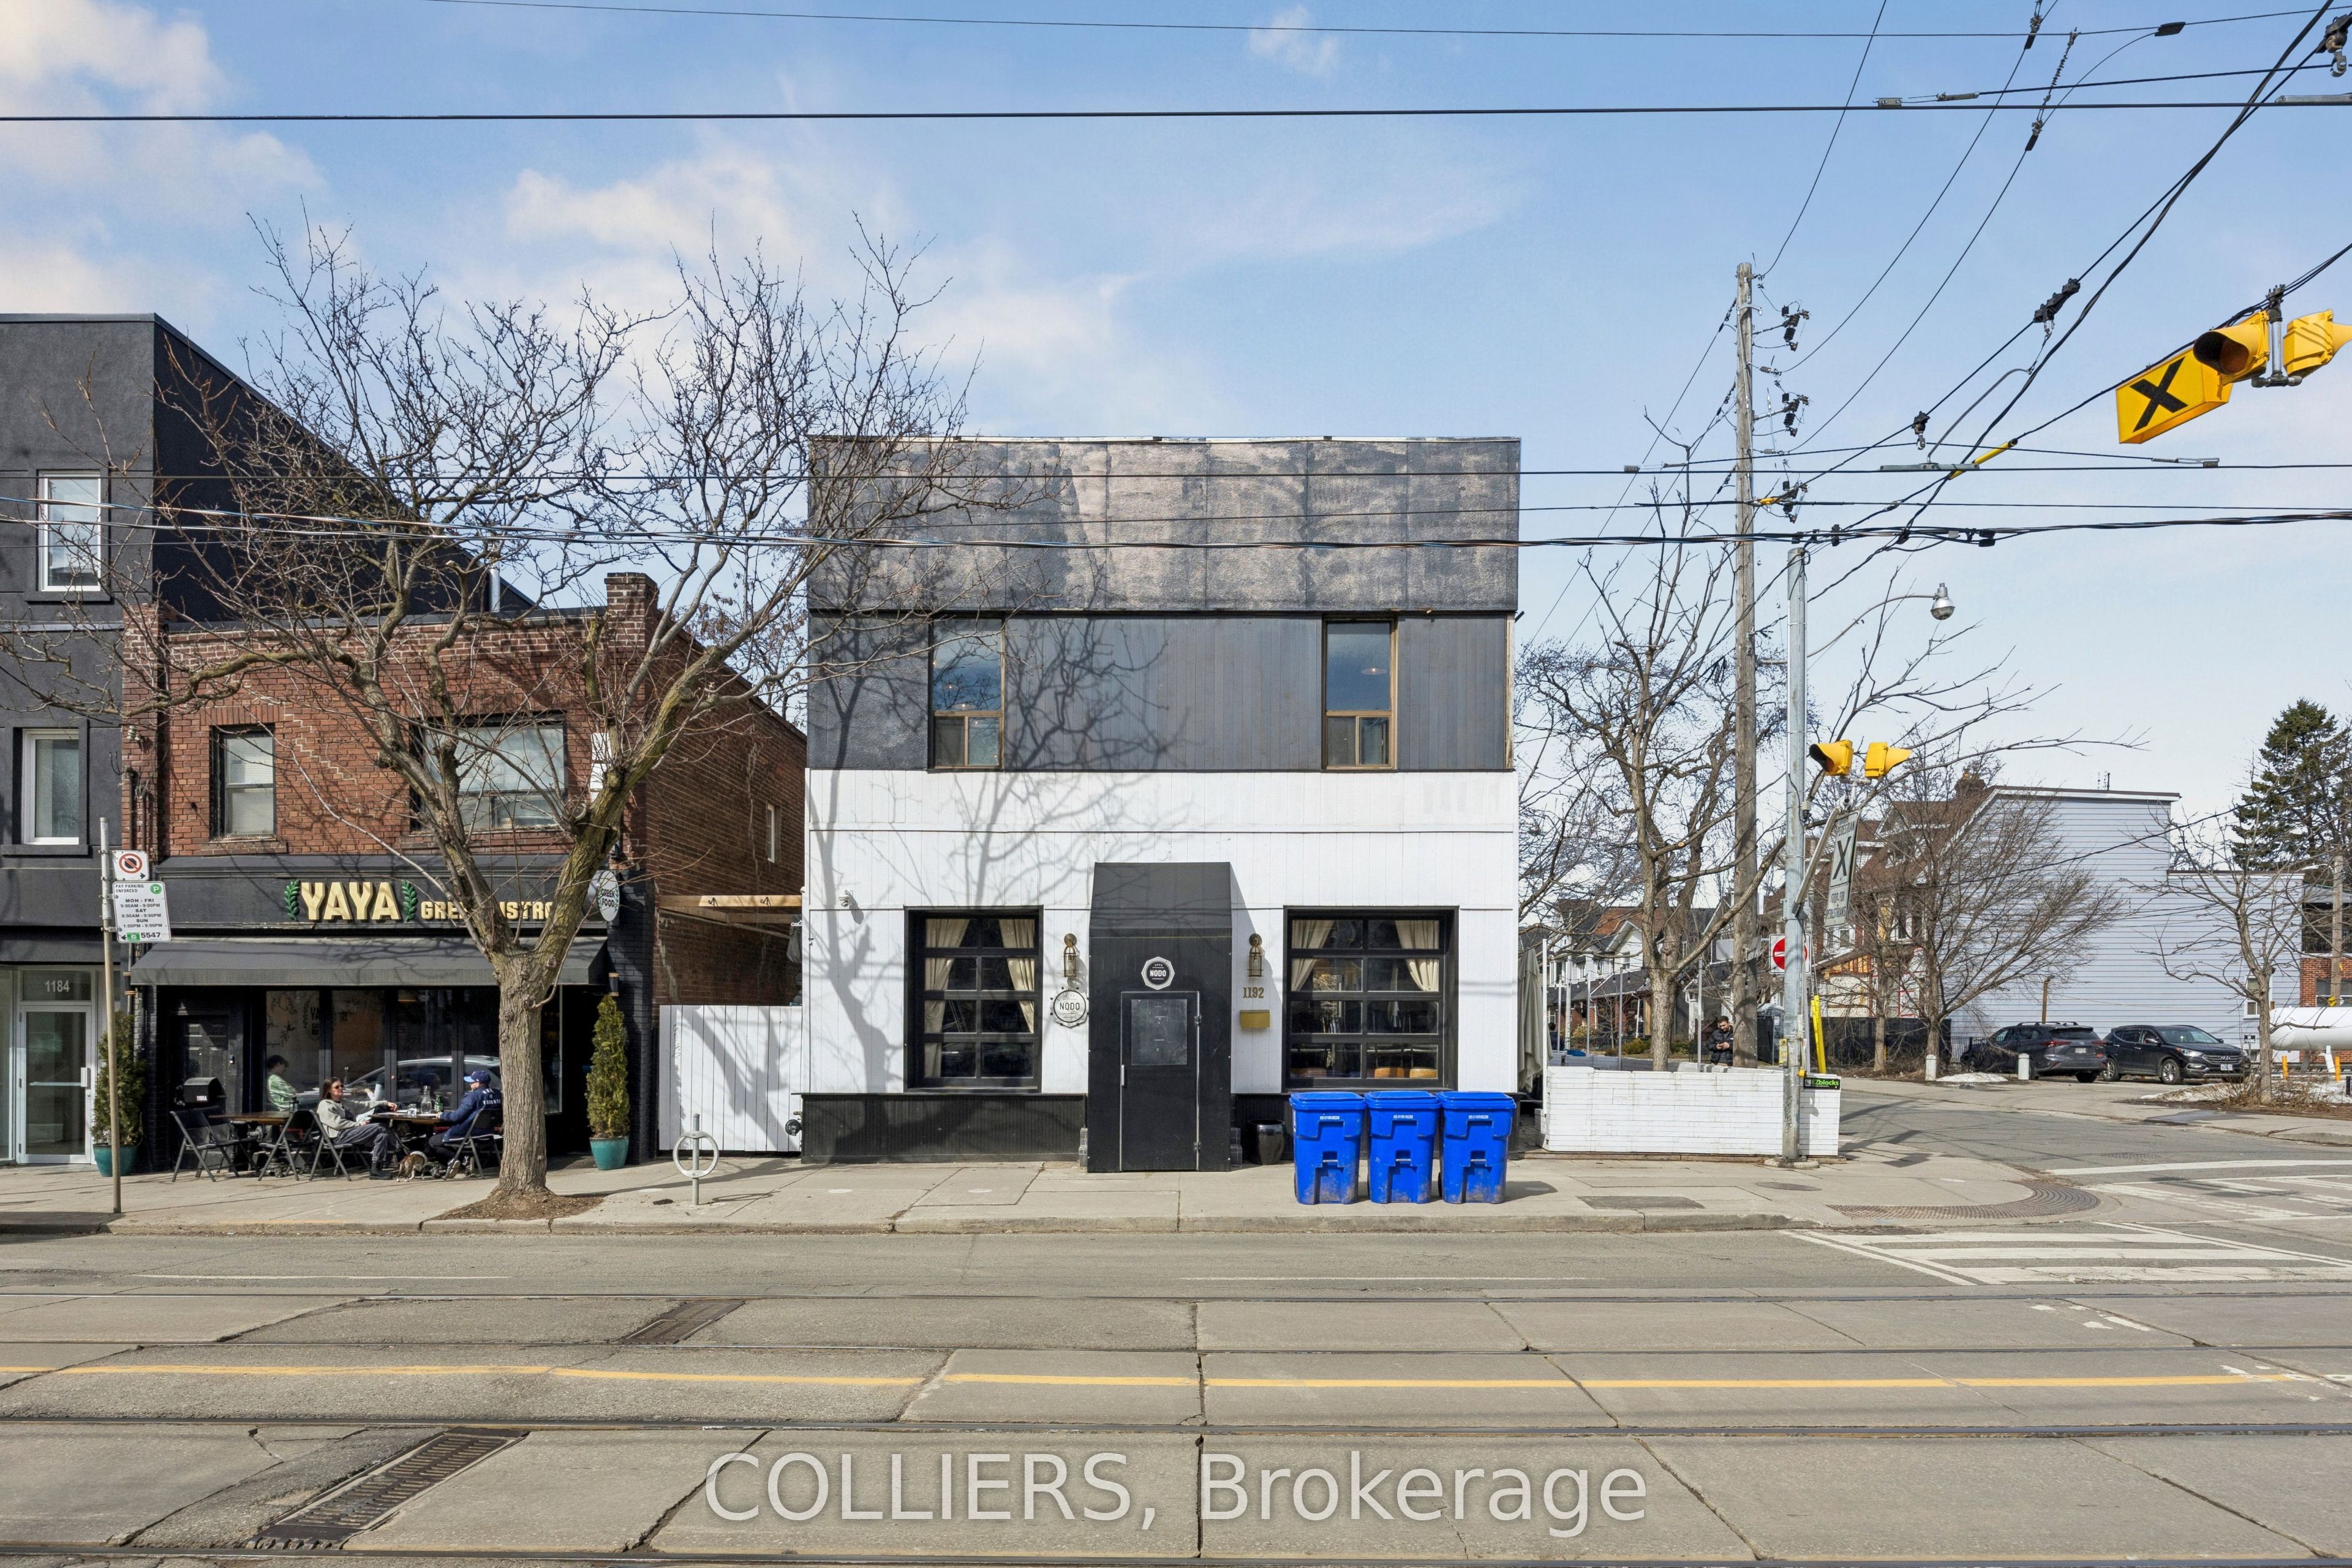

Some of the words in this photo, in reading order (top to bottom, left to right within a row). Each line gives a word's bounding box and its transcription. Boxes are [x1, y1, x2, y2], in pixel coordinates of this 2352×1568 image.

[601, 888, 615, 898] GREEK
[301, 881, 401, 920] YAYA
[601, 898, 615, 907] FOOD
[45, 980, 70, 992] 1184
[1243, 987, 1264, 998] 1192
[1060, 1002, 1080, 1011] NODO
